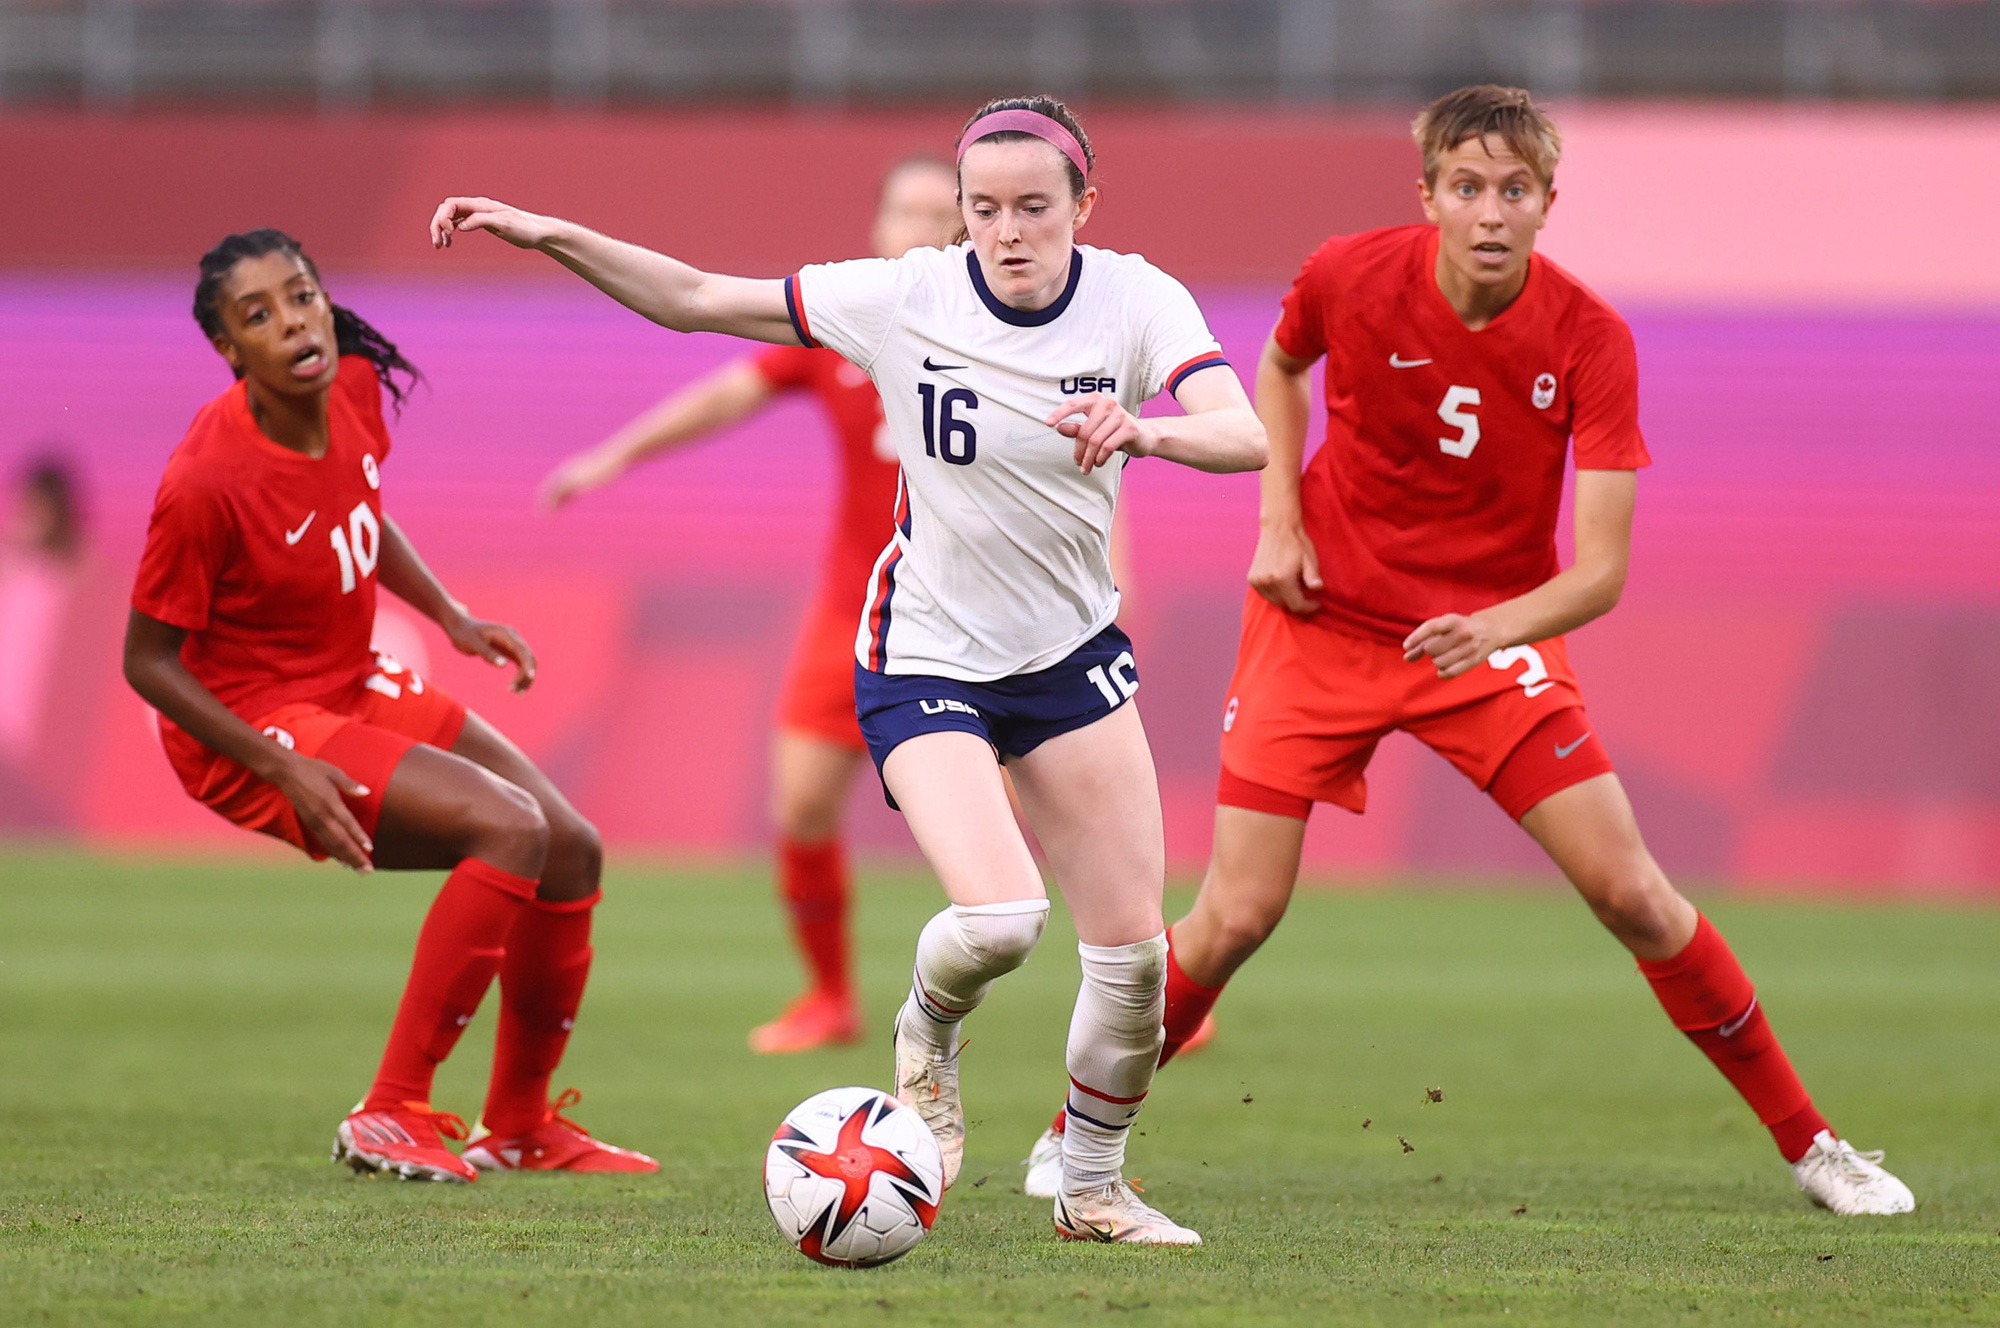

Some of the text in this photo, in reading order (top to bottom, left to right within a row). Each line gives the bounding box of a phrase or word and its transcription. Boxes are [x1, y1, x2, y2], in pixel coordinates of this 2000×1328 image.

[918, 382, 978, 466] 16
[1060, 376, 1116, 395] USA
[1437, 385, 1481, 459] 5
[330, 501, 380, 595] 10
